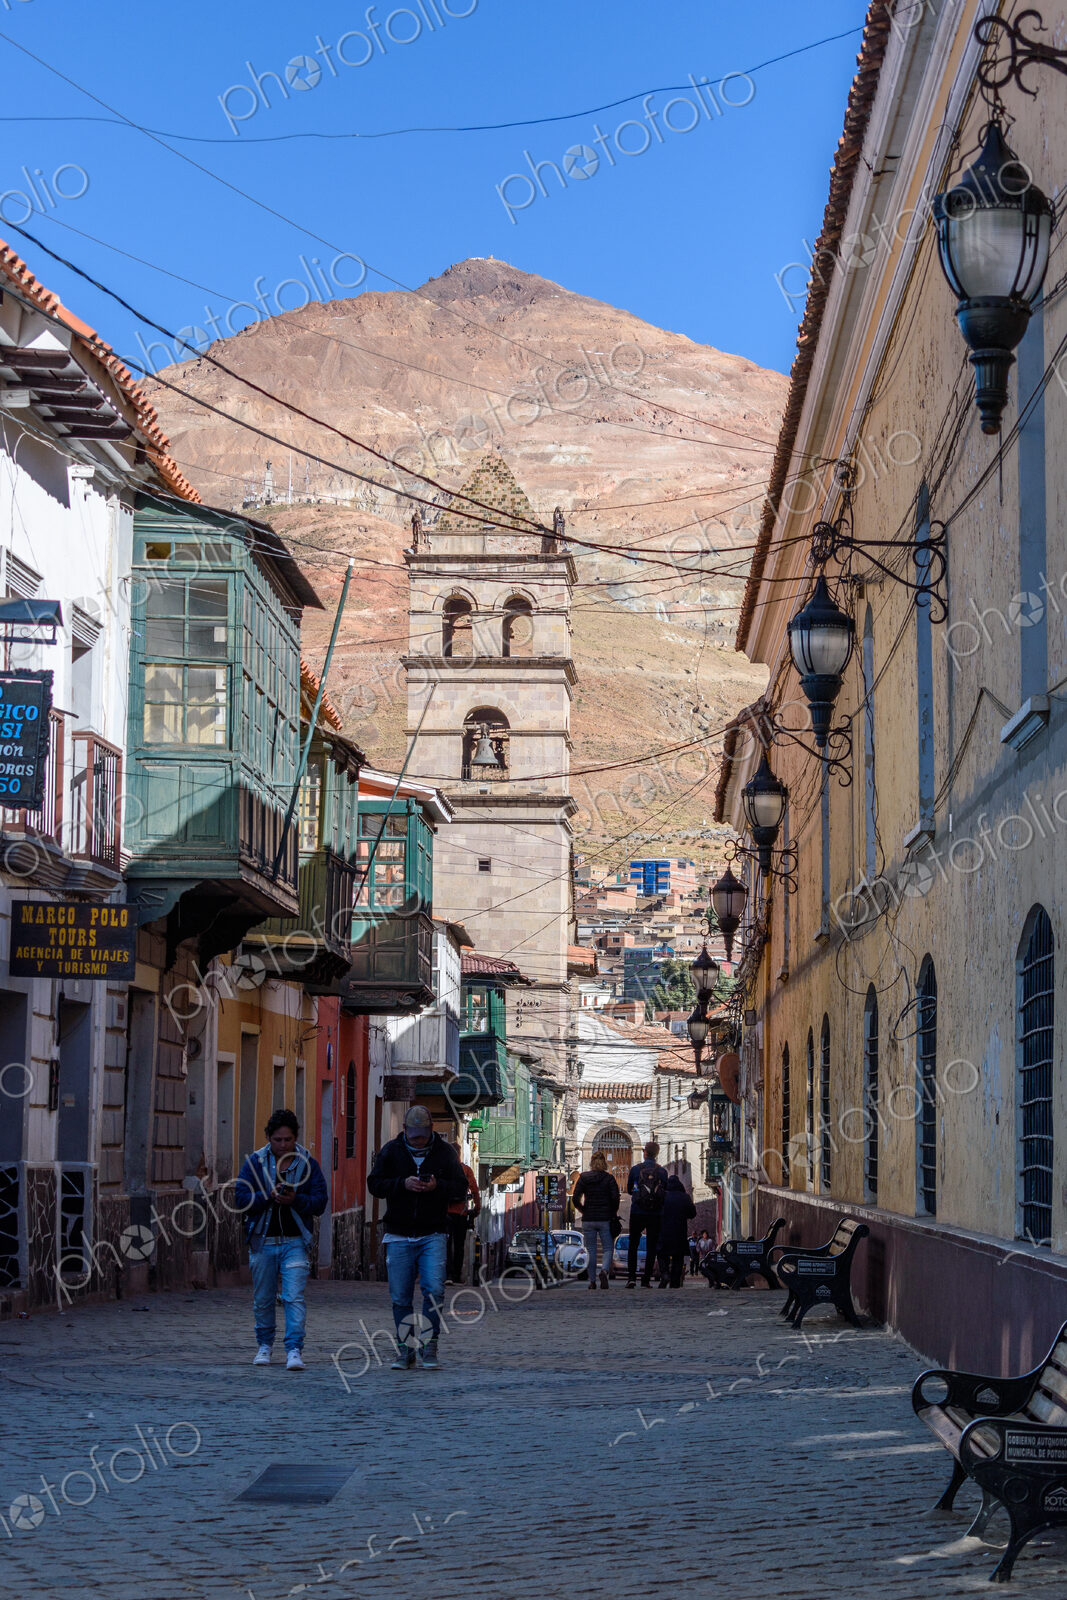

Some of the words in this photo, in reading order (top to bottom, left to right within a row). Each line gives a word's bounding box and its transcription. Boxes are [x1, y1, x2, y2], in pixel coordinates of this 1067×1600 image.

[21, 905, 76, 925] MARCO
[90, 907, 129, 928] POLO
[48, 927, 97, 947] TOURS
[16, 946, 63, 960] AGENCIA
[70, 948, 84, 960] DE
[90, 949, 129, 963] VIAJES
[36, 960, 44, 973] Y
[58, 961, 108, 975] TURISMO
